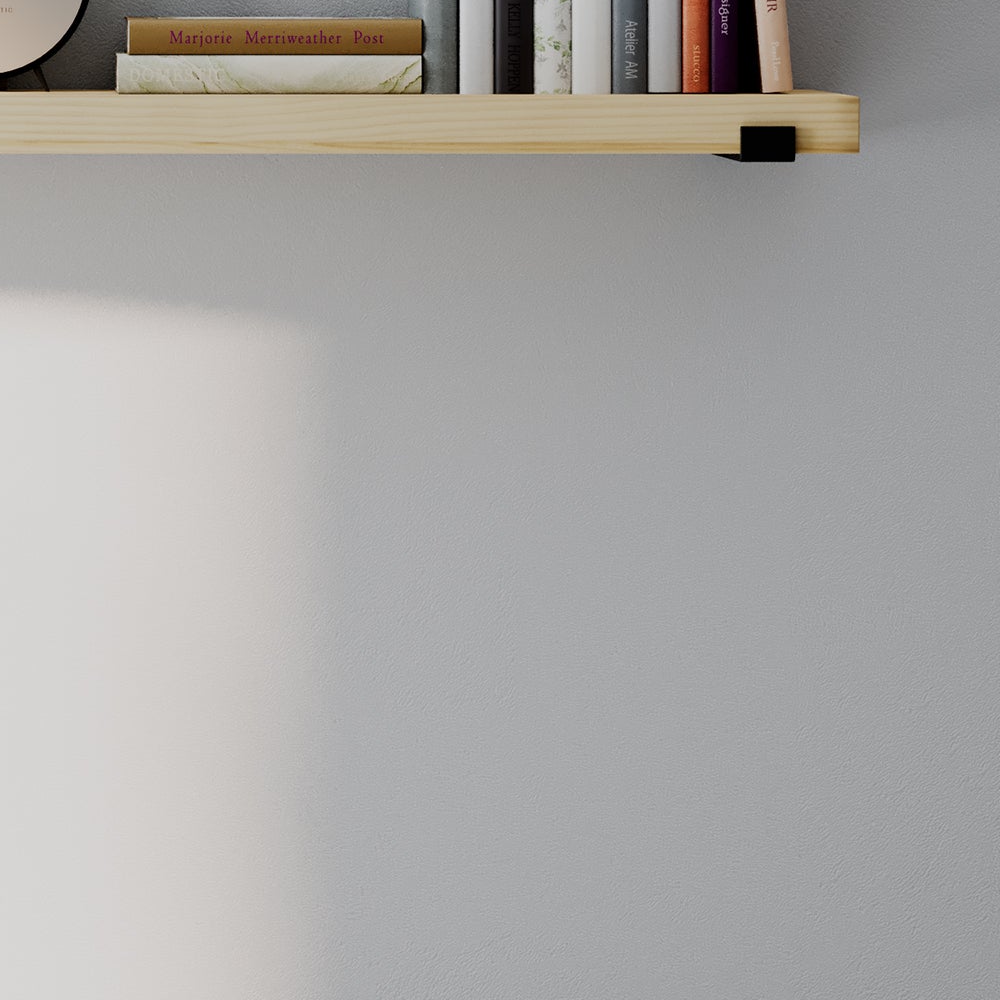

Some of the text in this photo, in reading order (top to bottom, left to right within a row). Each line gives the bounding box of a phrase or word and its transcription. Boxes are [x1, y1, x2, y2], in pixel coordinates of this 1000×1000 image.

[169, 29, 385, 48] Marjorie Merriweather Post
[507, 2, 521, 92] KELLY HOPPEN
[625, 19, 638, 80] Atelier AM
[692, 44, 701, 83] stucco
